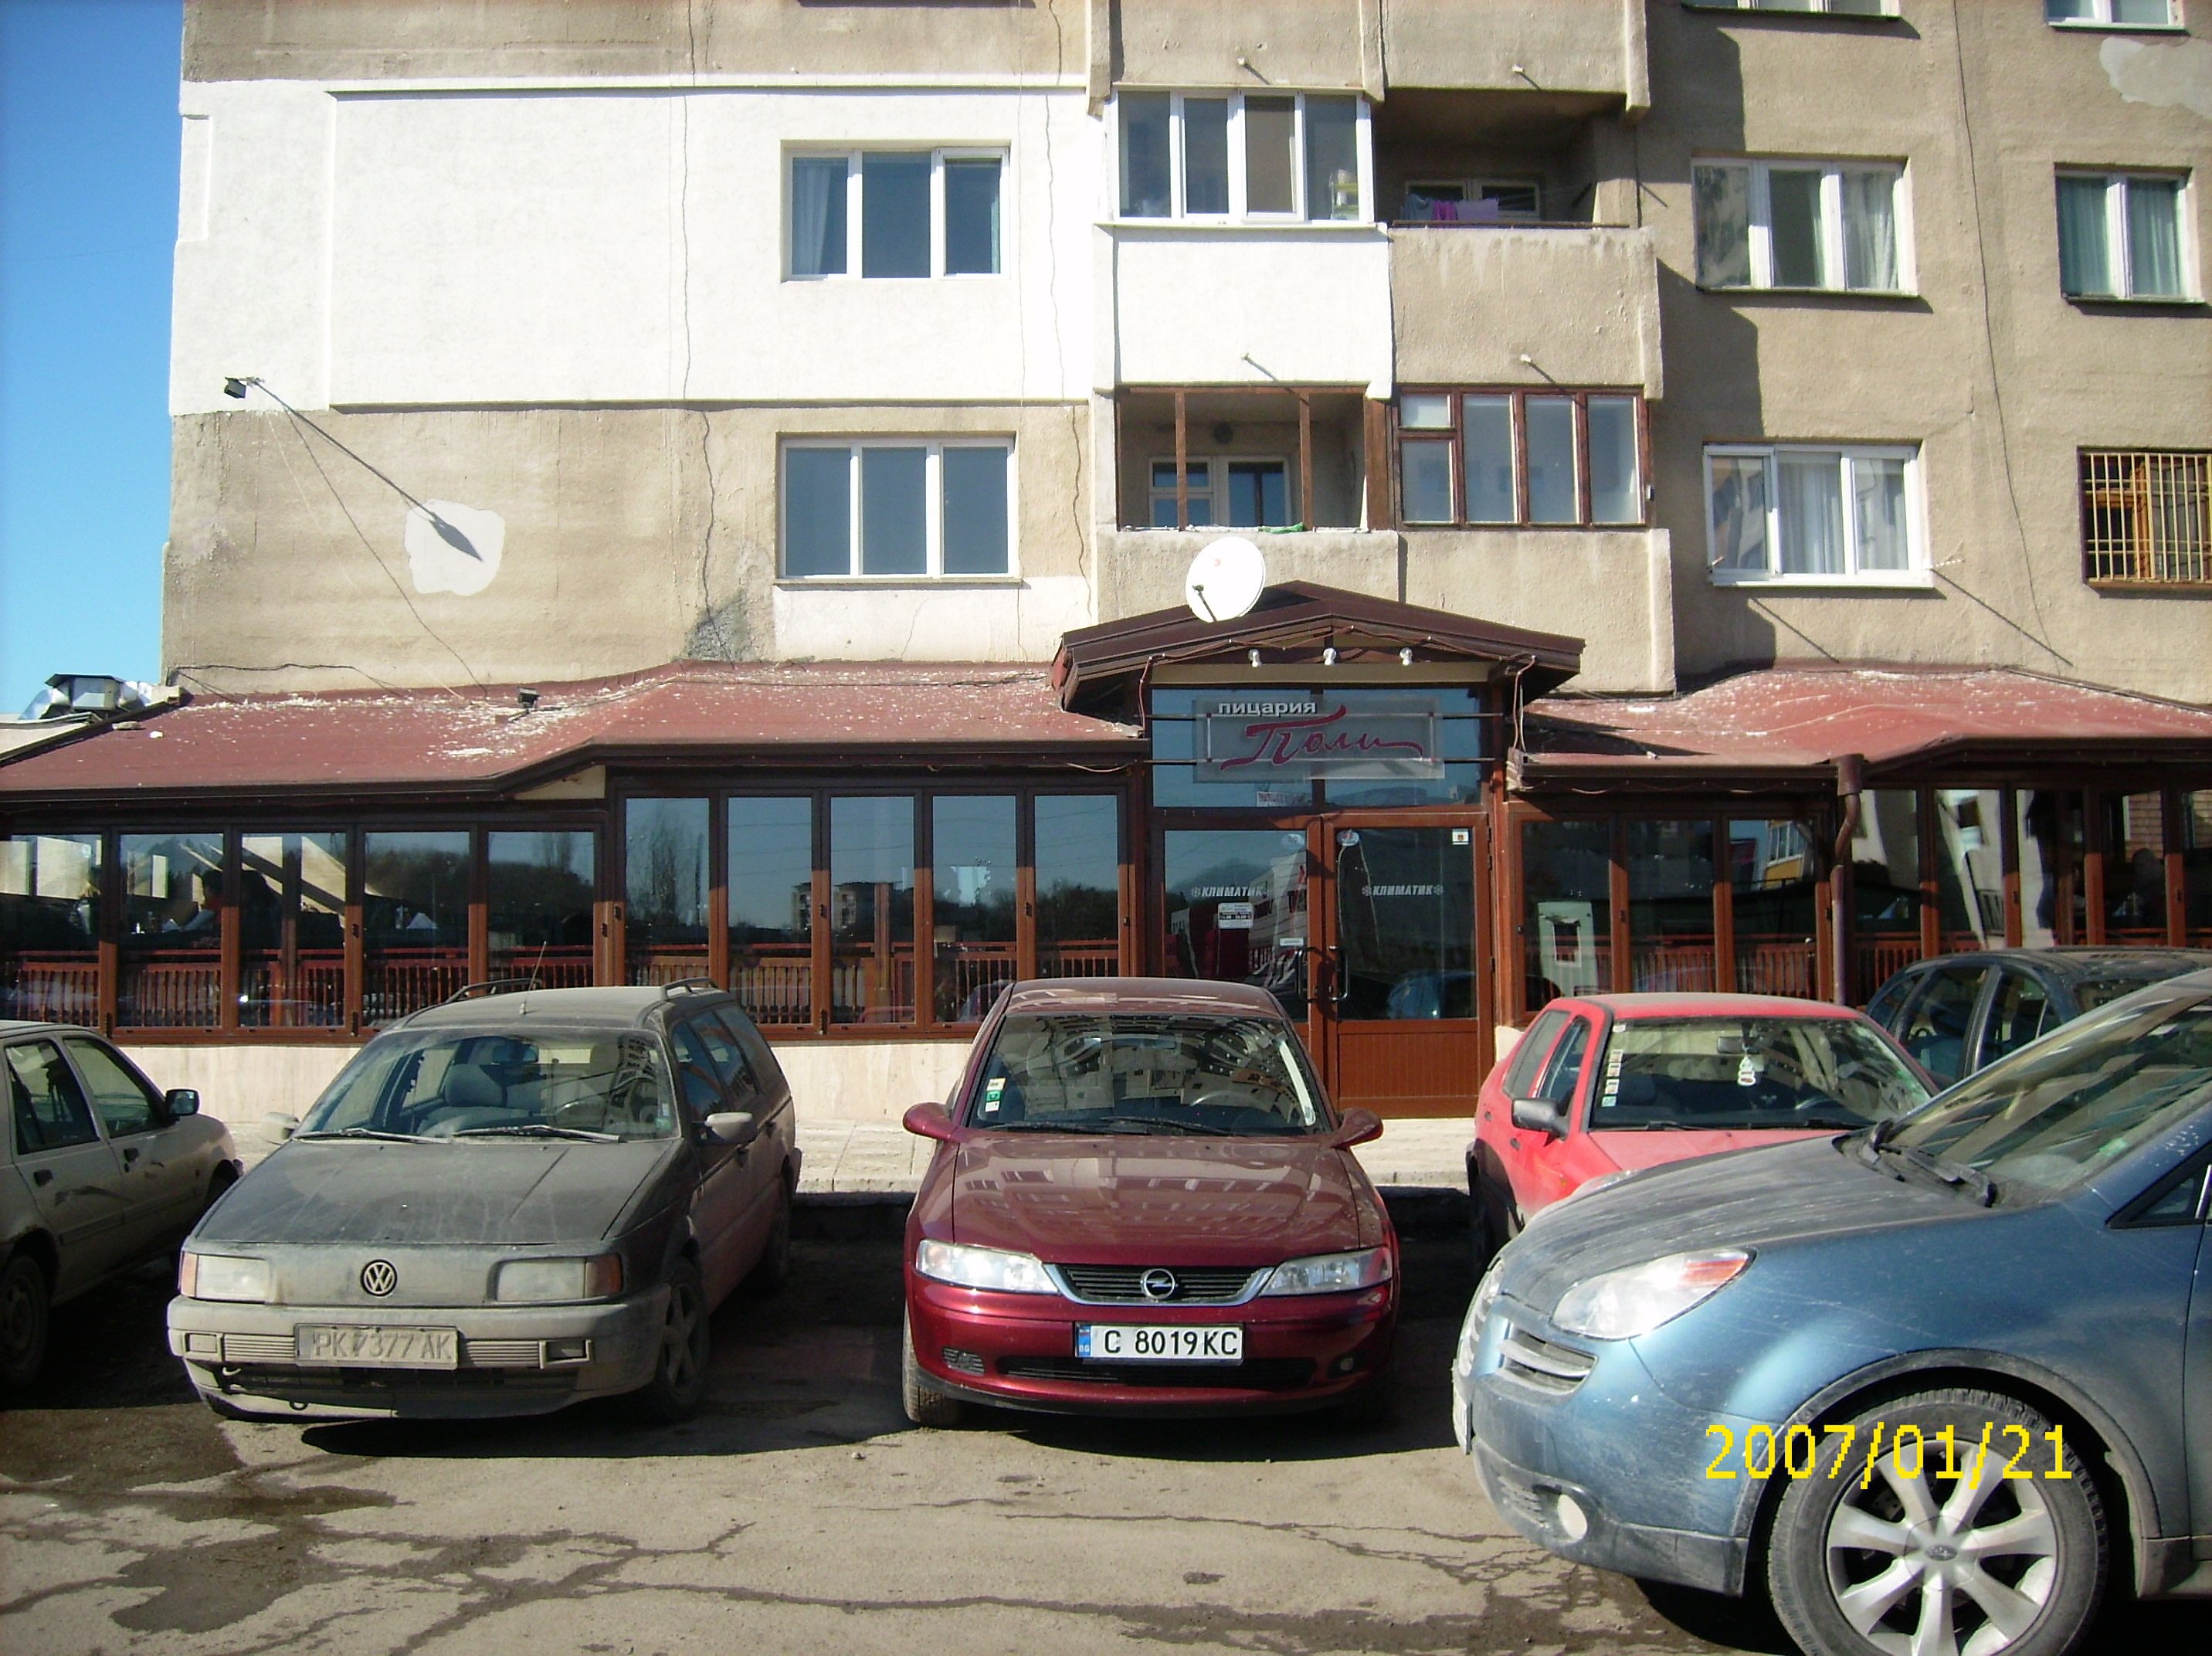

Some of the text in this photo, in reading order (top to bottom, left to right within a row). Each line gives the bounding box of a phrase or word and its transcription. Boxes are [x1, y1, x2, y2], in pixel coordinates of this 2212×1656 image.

[1217, 701, 1318, 717] пицария
[1220, 704, 1424, 771] Поли
[1201, 886, 1264, 897] КЛИМАТИК
[1372, 884, 1435, 896] КЛИМАТИК
